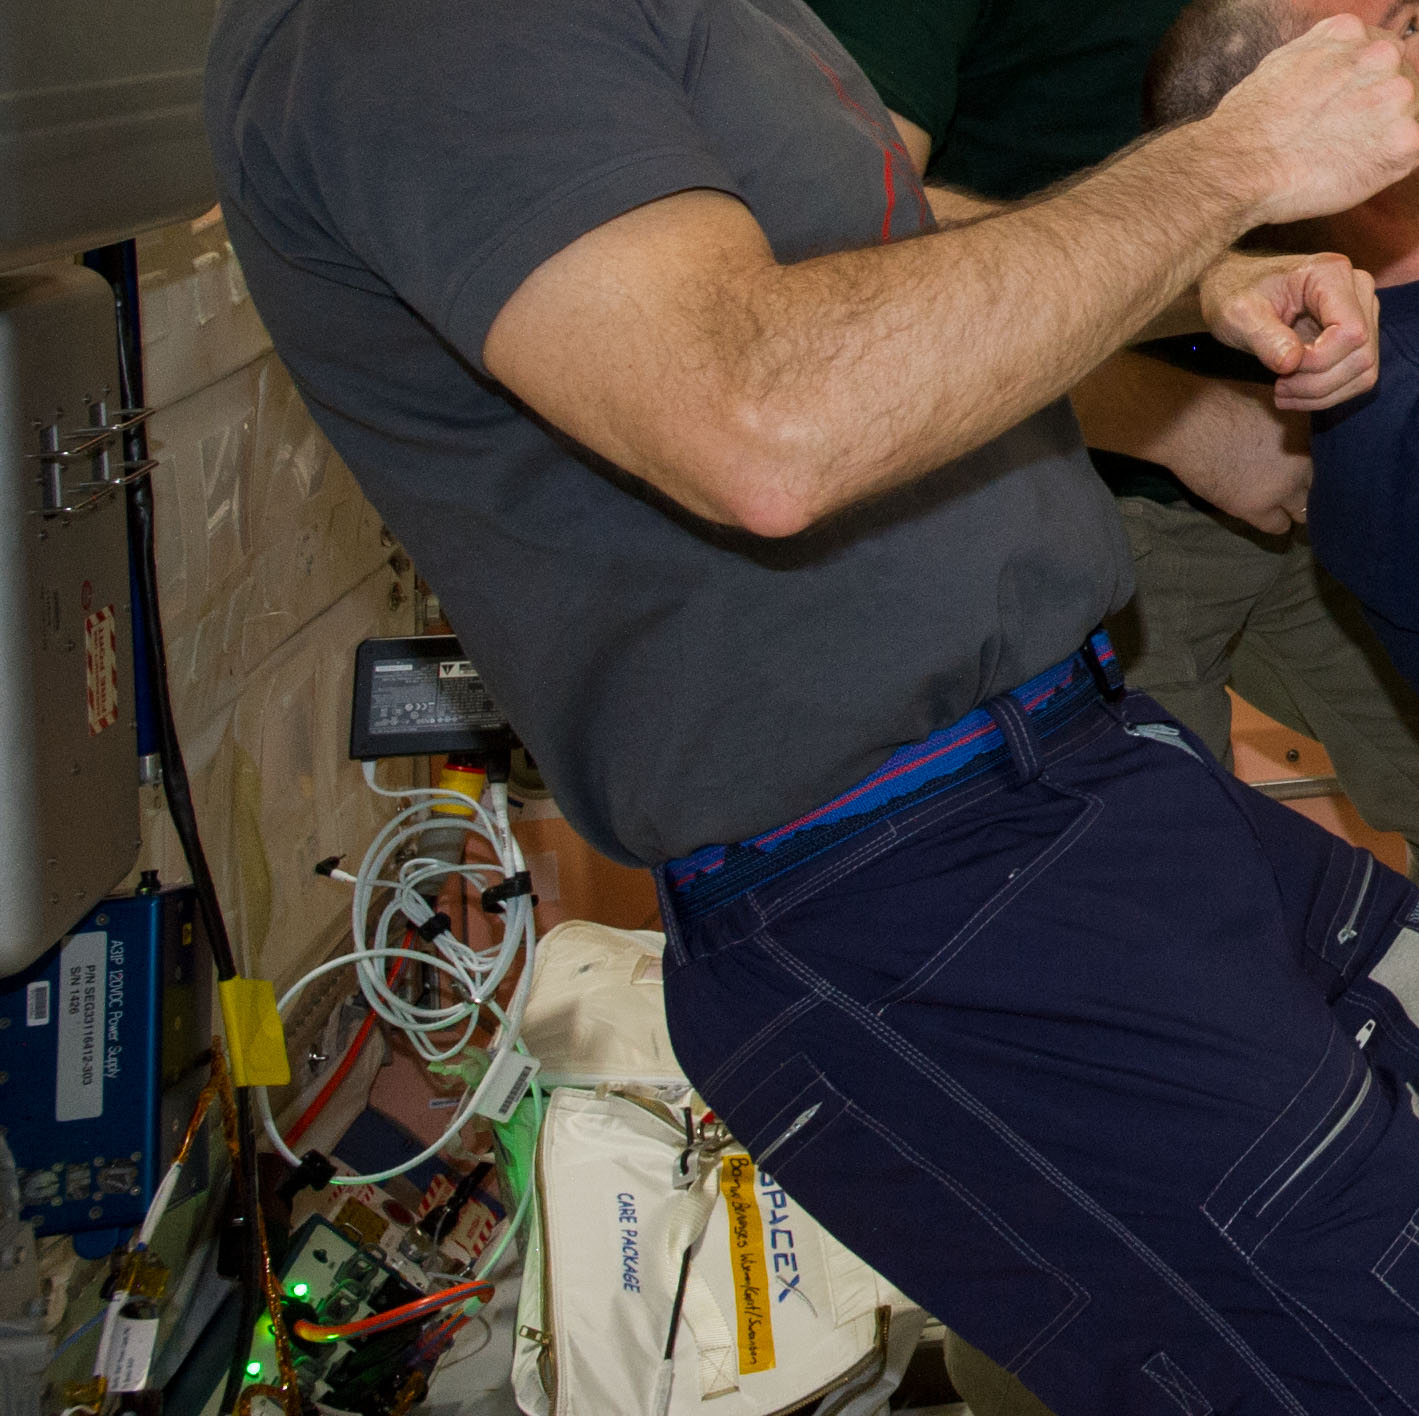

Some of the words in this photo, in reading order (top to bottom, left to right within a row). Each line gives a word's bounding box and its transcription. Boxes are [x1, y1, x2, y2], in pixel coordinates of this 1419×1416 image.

[109, 940, 124, 966] A31P
[70, 966, 81, 986] S/N
[85, 964, 96, 984] P/N
[108, 970, 124, 1008] 120VDC
[68, 991, 81, 1015] 1426
[108, 1011, 123, 1041] Power
[104, 1045, 122, 1080] Supply
[617, 1192, 637, 1224] CARE
[621, 1229, 641, 1294] PACKAGE
